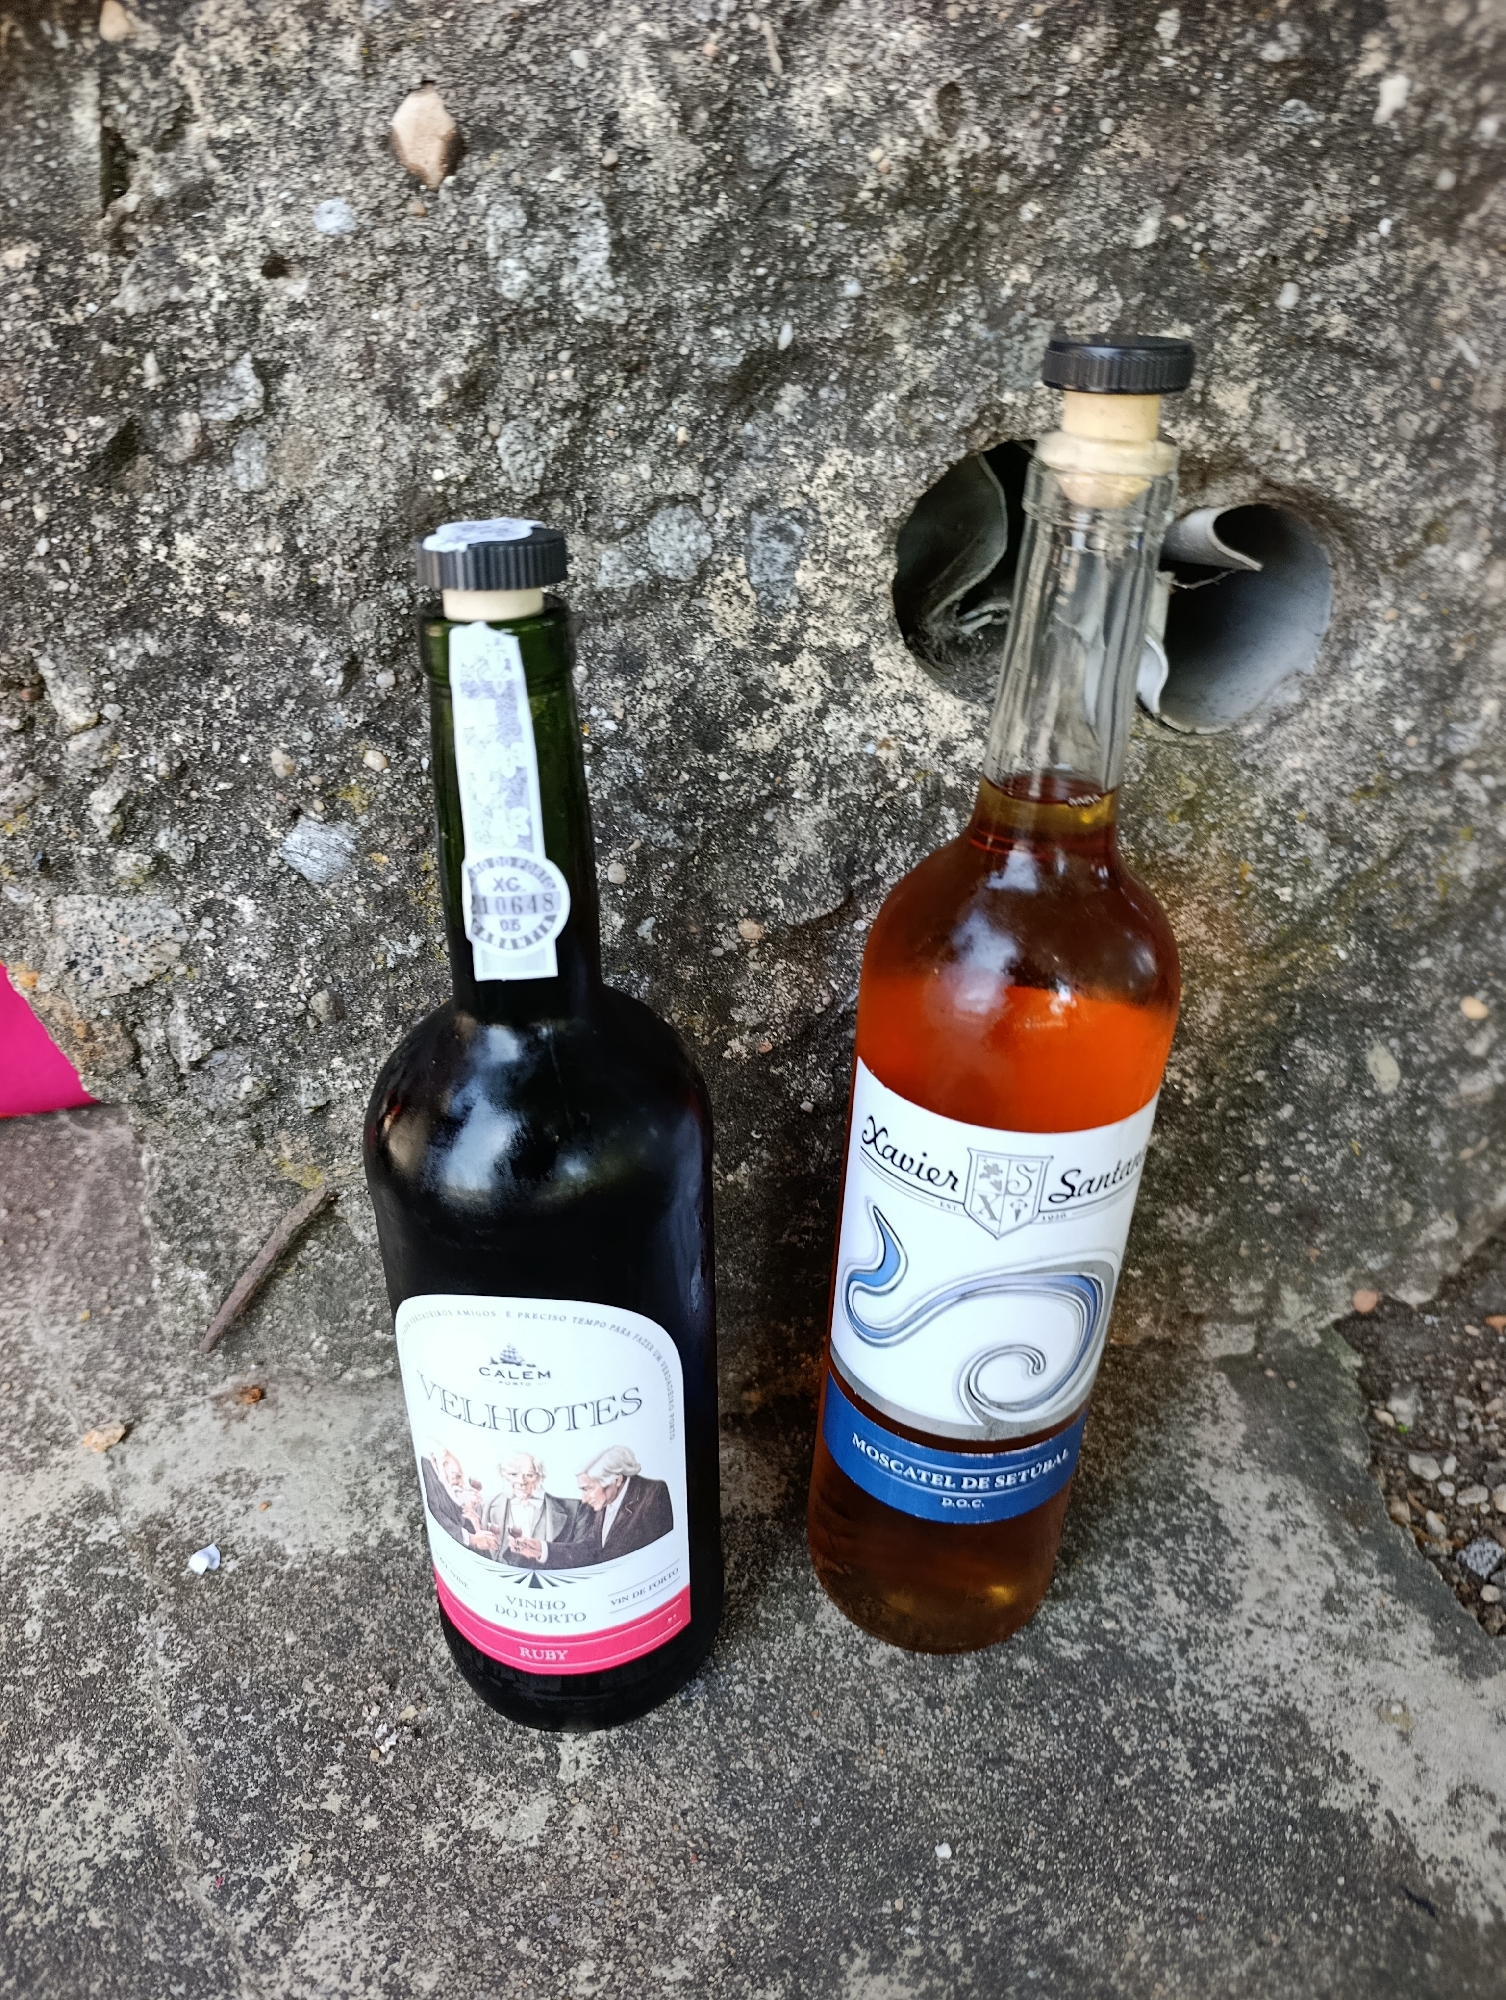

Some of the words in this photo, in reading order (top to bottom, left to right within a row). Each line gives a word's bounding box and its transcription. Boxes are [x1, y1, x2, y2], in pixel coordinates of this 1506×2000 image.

[861, 1115, 958, 1193] Xavier
[517, 1312, 567, 1322] PRECISO
[572, 1316, 607, 1328] TEMPO
[609, 1324, 631, 1337] PARA
[416, 1369, 643, 1434] VELHOTES
[852, 1432, 955, 1488] MOSCATEL
[961, 1475, 991, 1490] DE
[610, 1594, 629, 1606] VIN
[632, 1587, 647, 1599] DE
[648, 1567, 679, 1591] PORTO
[494, 1603, 519, 1619] DO
[524, 1612, 587, 1624] PORTO
[505, 1595, 566, 1611] VINHO
[519, 1646, 568, 1661] RUBY
